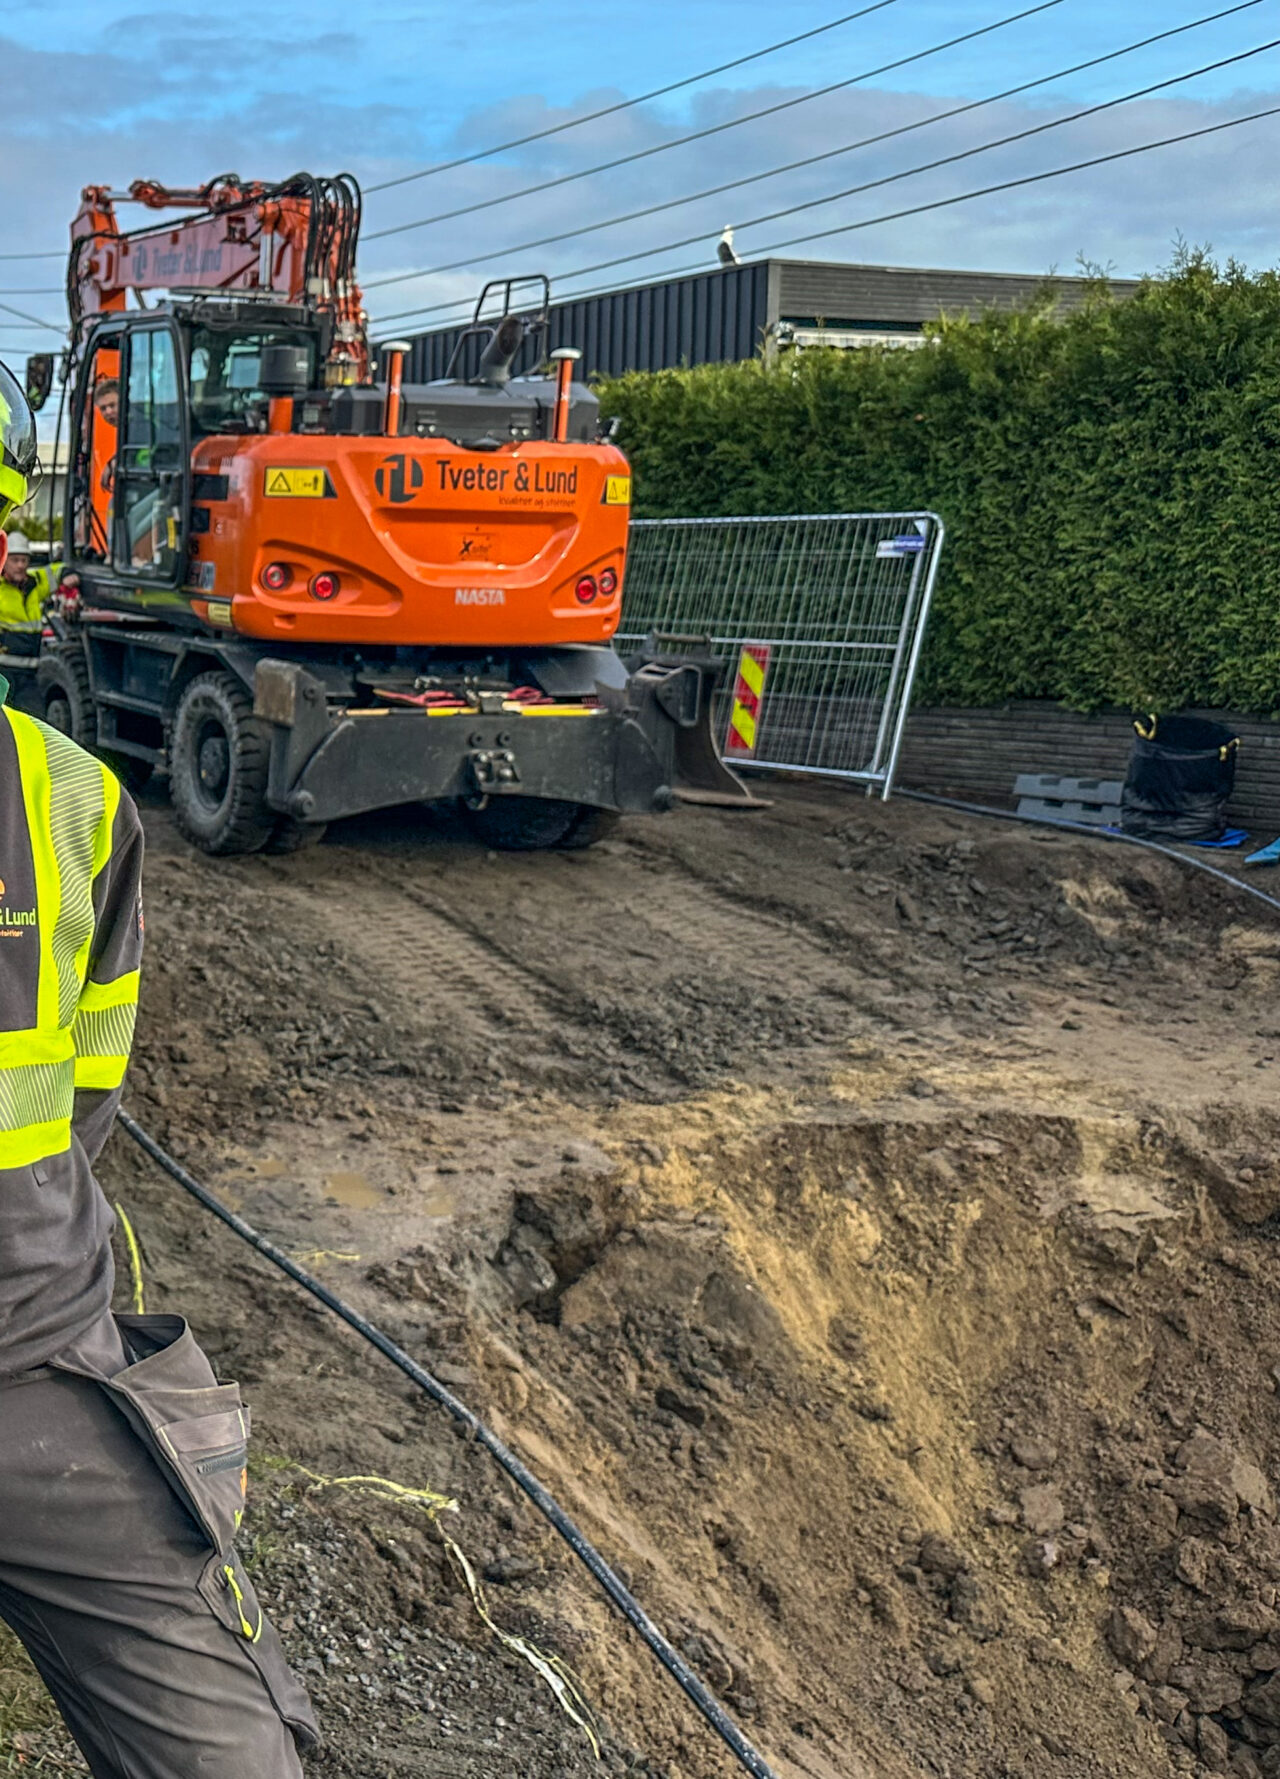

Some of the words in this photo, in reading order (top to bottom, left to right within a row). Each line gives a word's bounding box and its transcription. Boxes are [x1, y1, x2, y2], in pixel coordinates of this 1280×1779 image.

[436, 460, 510, 490] Tveter
[514, 462, 529, 492] &
[535, 463, 578, 494] Lund
[455, 588, 506, 606] NASTA
[5, 907, 37, 926] Lund
